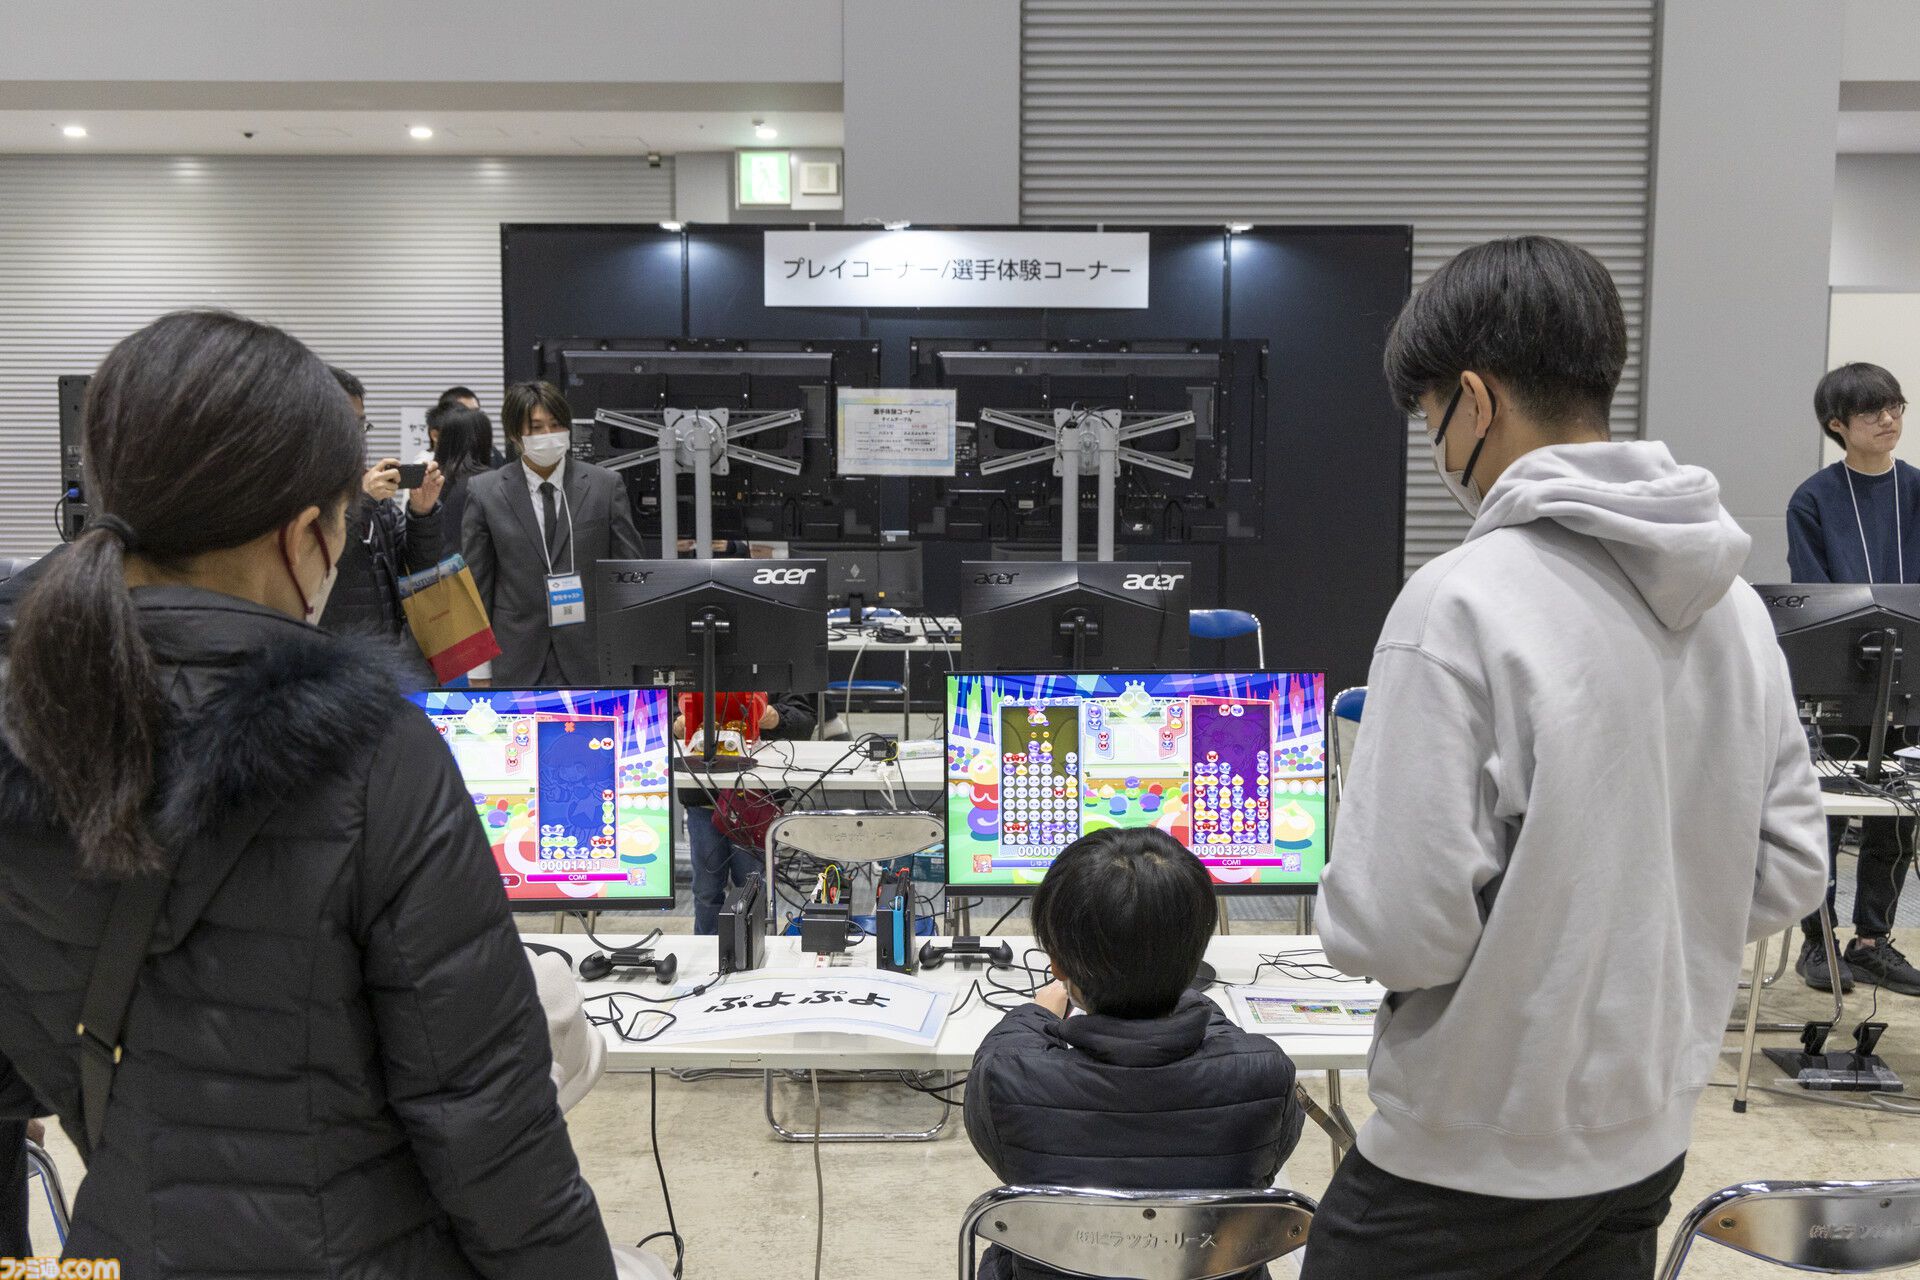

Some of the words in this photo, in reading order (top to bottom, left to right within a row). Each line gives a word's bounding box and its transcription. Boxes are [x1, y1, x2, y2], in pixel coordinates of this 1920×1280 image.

[783, 257, 1131, 281] プレイコーナー/選手体験コーナー
[611, 571, 654, 584] acer
[753, 568, 816, 585] acer
[974, 572, 1020, 585] acer
[1122, 573, 1185, 591] acer
[1765, 594, 1810, 608] acer
[1193, 845, 1256, 855] 00003226
[540, 860, 601, 871] 00001411
[703, 990, 891, 1012] ぷよぷよ
